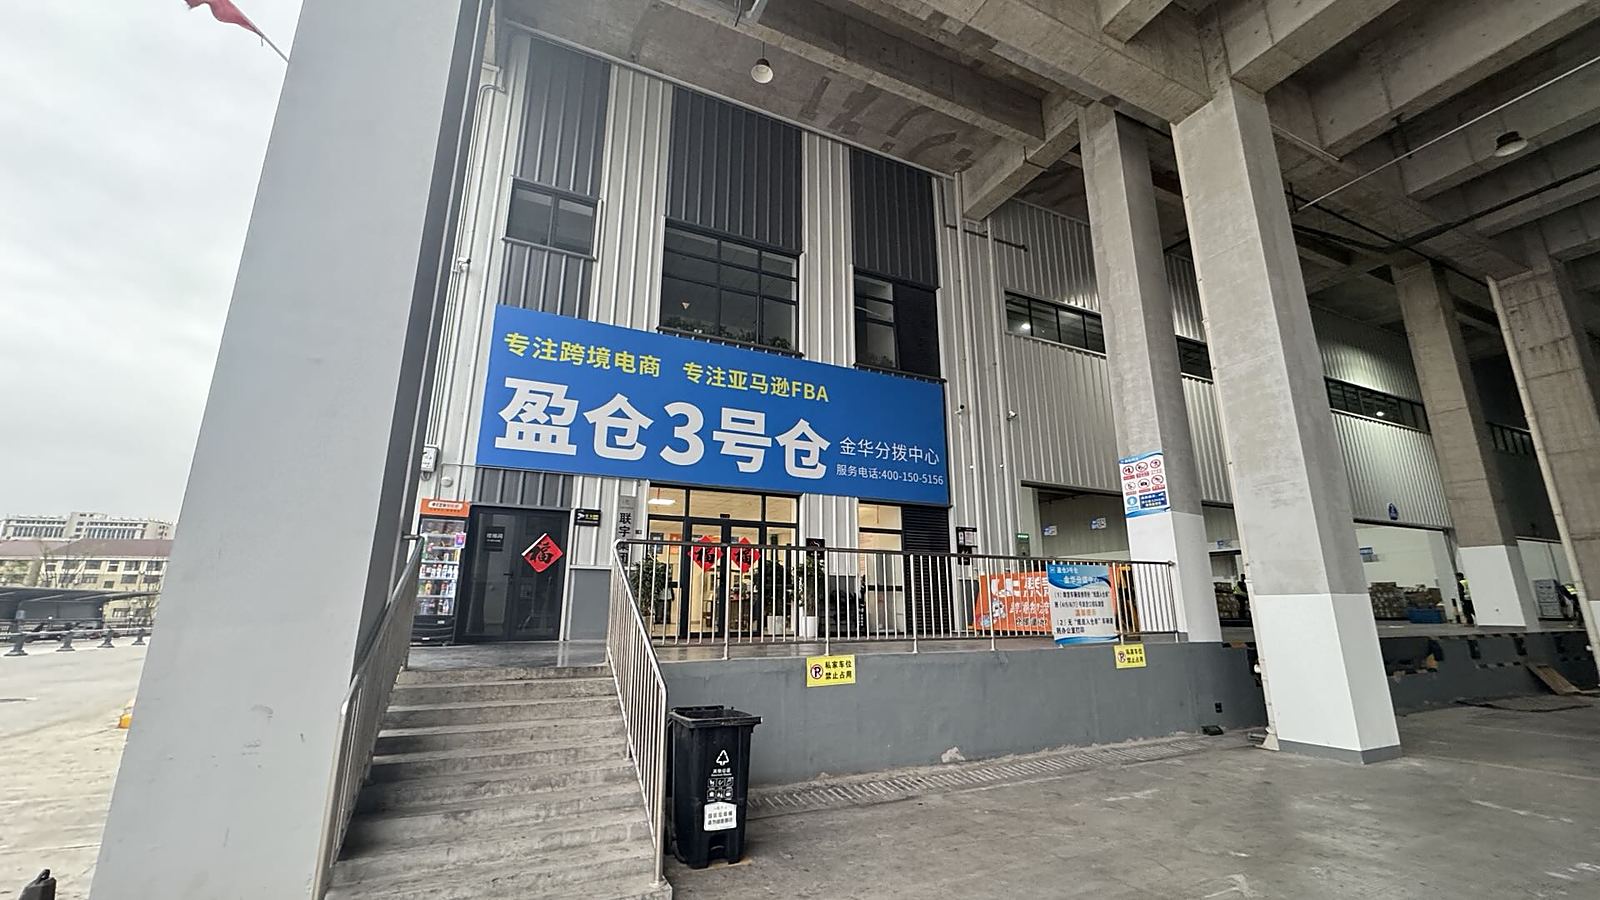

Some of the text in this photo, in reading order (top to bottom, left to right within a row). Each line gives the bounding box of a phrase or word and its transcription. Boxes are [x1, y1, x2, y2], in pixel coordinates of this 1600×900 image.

[503, 331, 829, 403] 专注跨境电商 专注亚马逊FBA
[494, 376, 831, 481] 盈仓3号仓
[838, 436, 941, 466] 金华分拨中心
[835, 464, 945, 486] 服务电话:400-150-5156
[530, 541, 554, 564] 福
[825, 660, 852, 669] 私家车位
[825, 670, 852, 680] 禁止占用
